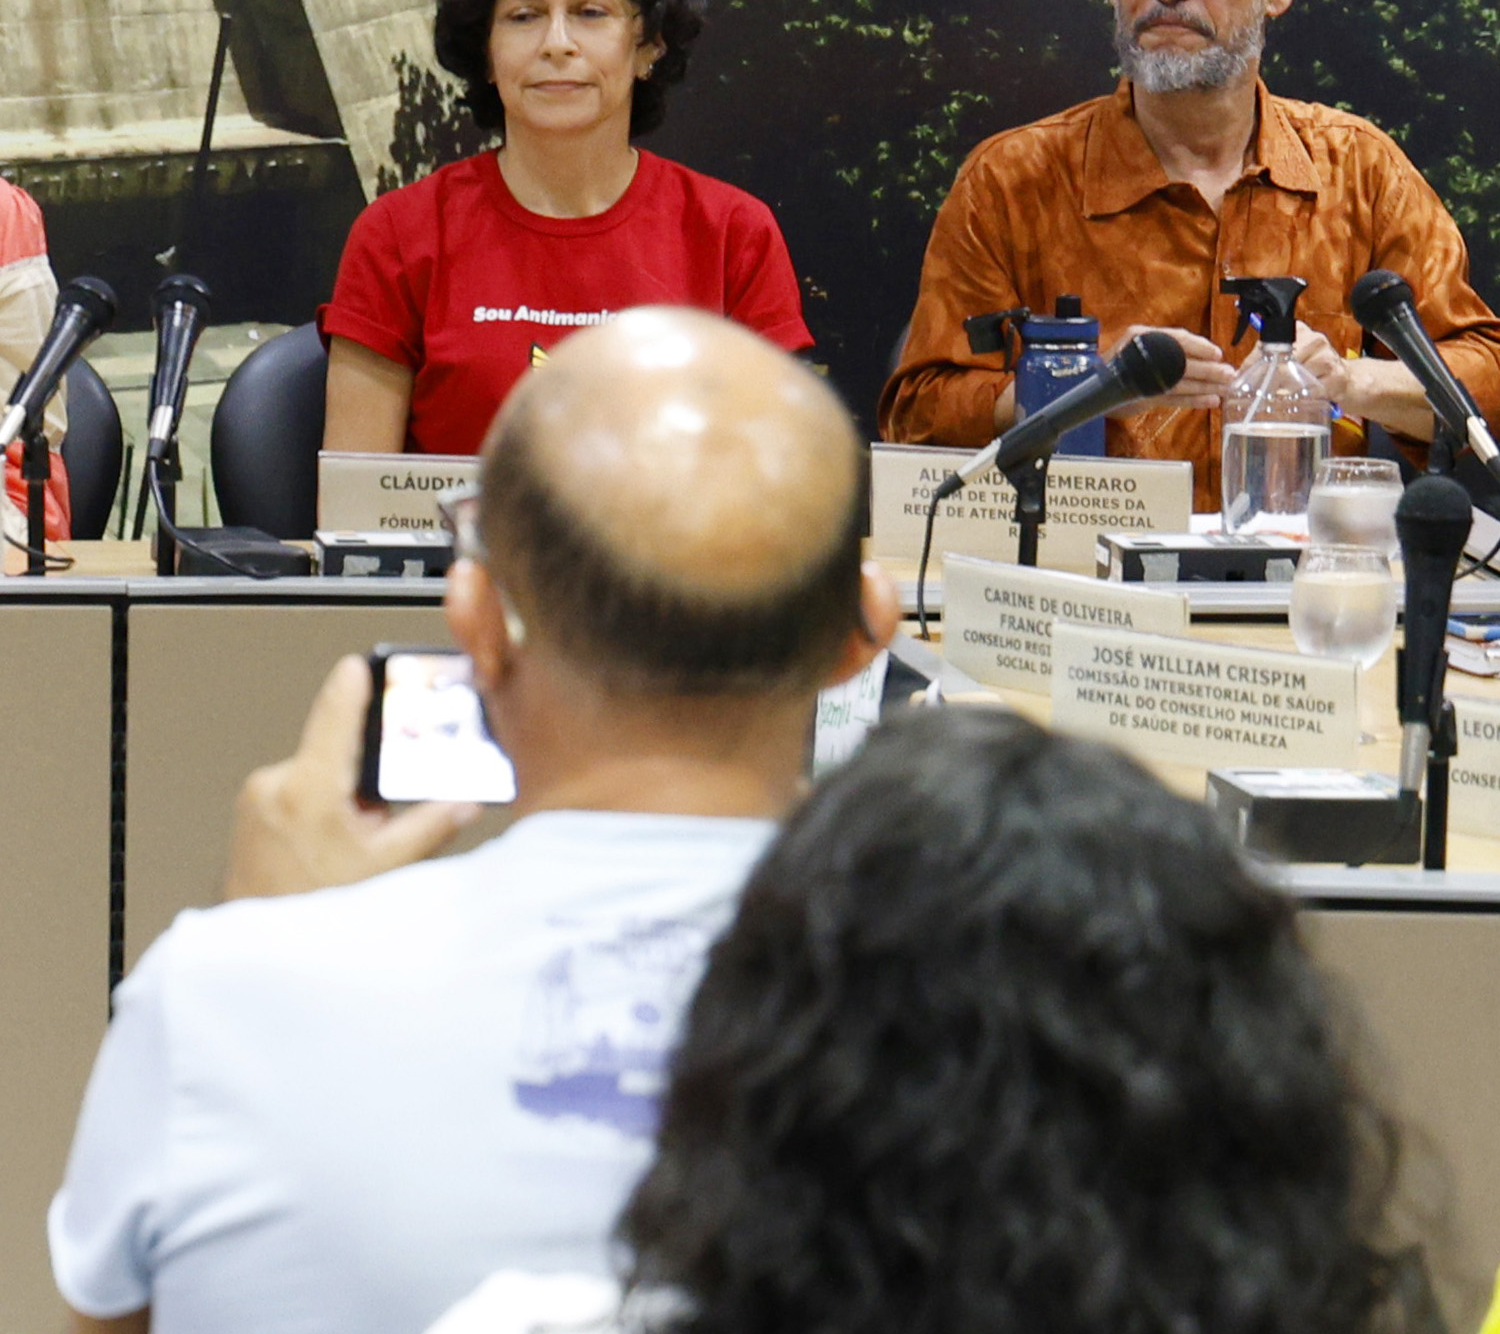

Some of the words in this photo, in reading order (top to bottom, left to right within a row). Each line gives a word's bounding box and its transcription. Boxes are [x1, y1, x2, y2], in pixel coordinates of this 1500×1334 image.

[473, 305, 512, 322] Sou
[1045, 474, 1137, 493] EMERARO
[946, 506, 965, 519] DE
[967, 490, 987, 503] DE
[1124, 498, 1146, 511] DA
[983, 587, 1035, 611] CARINE
[1040, 597, 1058, 615] DE
[1062, 601, 1134, 628] OLIVEIRA
[963, 629, 1022, 652] CONSELHO
[1024, 640, 1052, 657] REGI
[996, 654, 1036, 673] SOCIAL
[1092, 644, 1134, 668] JOSÉ
[1140, 654, 1220, 679] WILLIAM
[1227, 666, 1306, 691] CRISPIM
[1068, 666, 1138, 689] COMISSÃO
[1144, 677, 1257, 704] INTERSETORIAL
[1263, 693, 1280, 708] DE
[1286, 693, 1336, 716] SAÚDE
[1077, 688, 1129, 711] MENTAL
[1135, 695, 1155, 712] DO
[1160, 700, 1234, 722] CONSELHO
[1240, 709, 1324, 734] MUNICIPAL
[1109, 713, 1127, 727] DE
[1132, 714, 1177, 734] SAÚDE
[1183, 722, 1201, 737] DE
[1206, 725, 1288, 750] FORTALEZA
